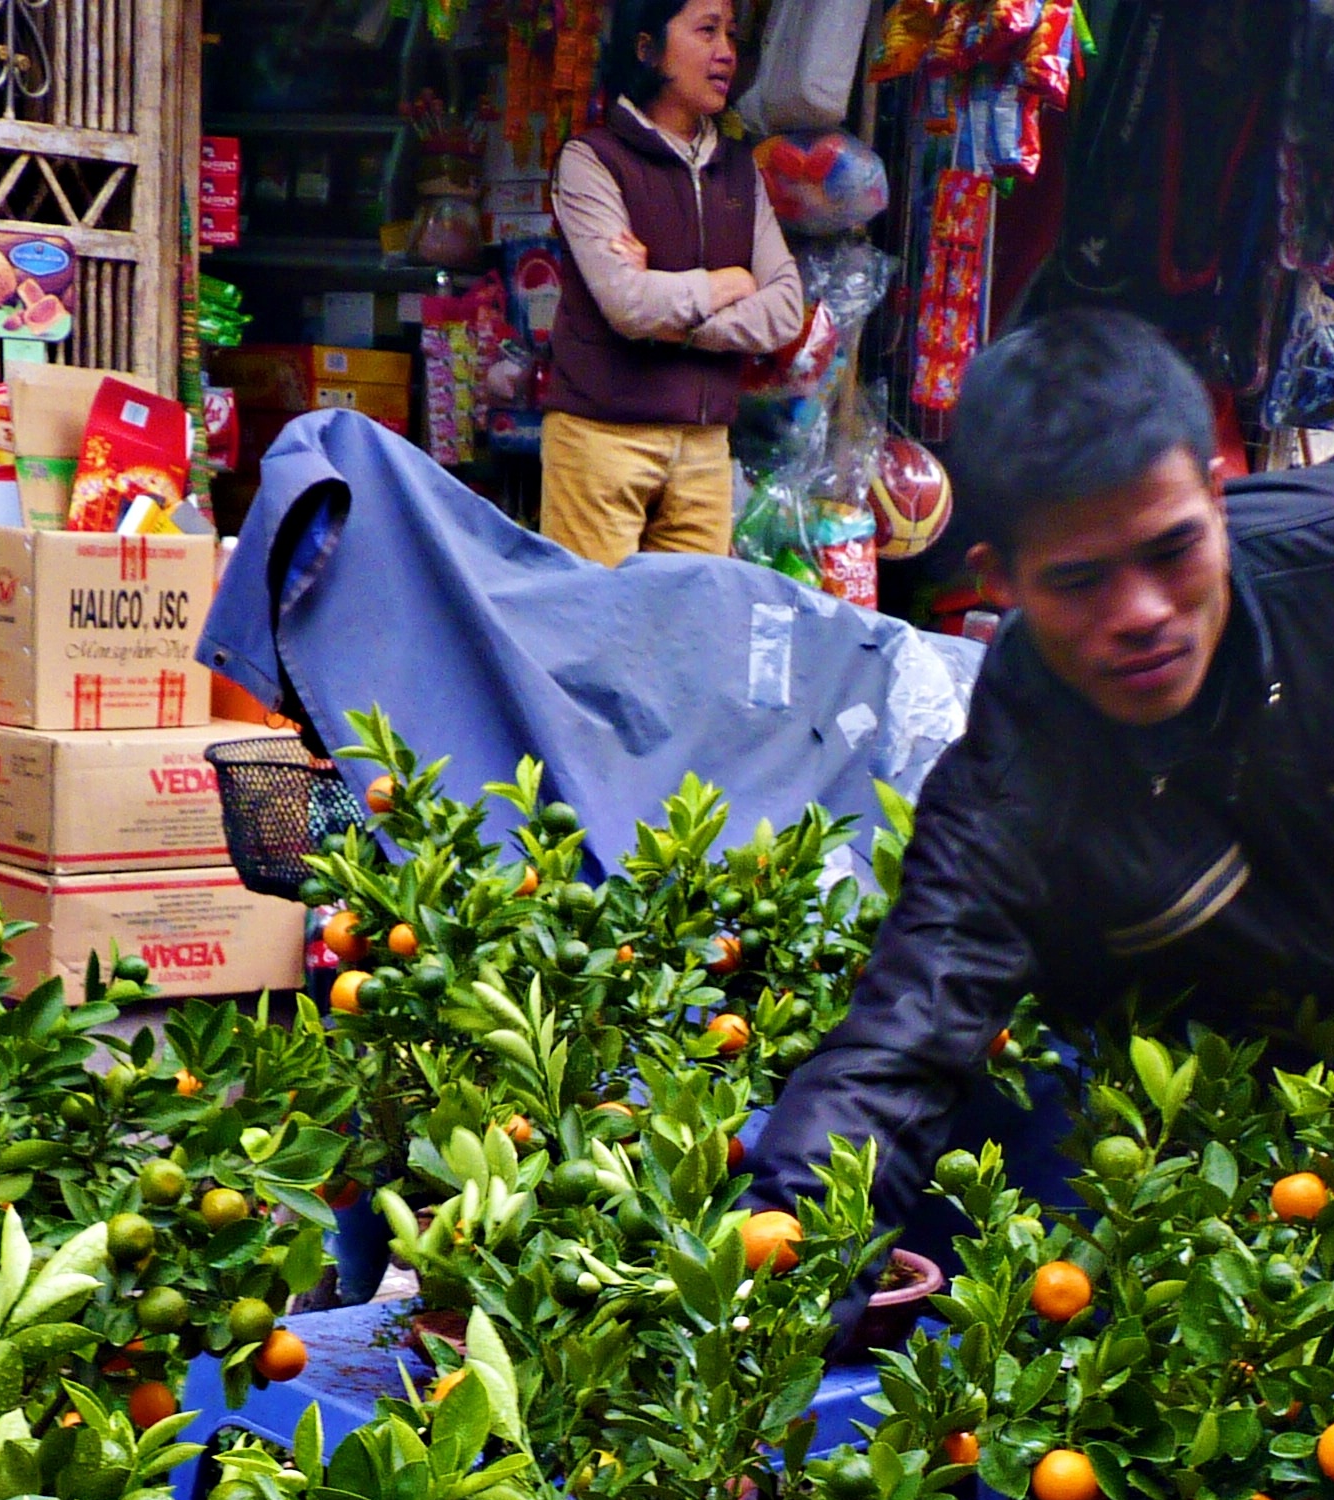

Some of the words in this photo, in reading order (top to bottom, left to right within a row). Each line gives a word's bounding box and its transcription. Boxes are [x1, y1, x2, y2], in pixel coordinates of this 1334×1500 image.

[153, 589, 189, 630] JSC
[149, 768, 220, 795] VEDA
[142, 941, 226, 969] VEDAN
